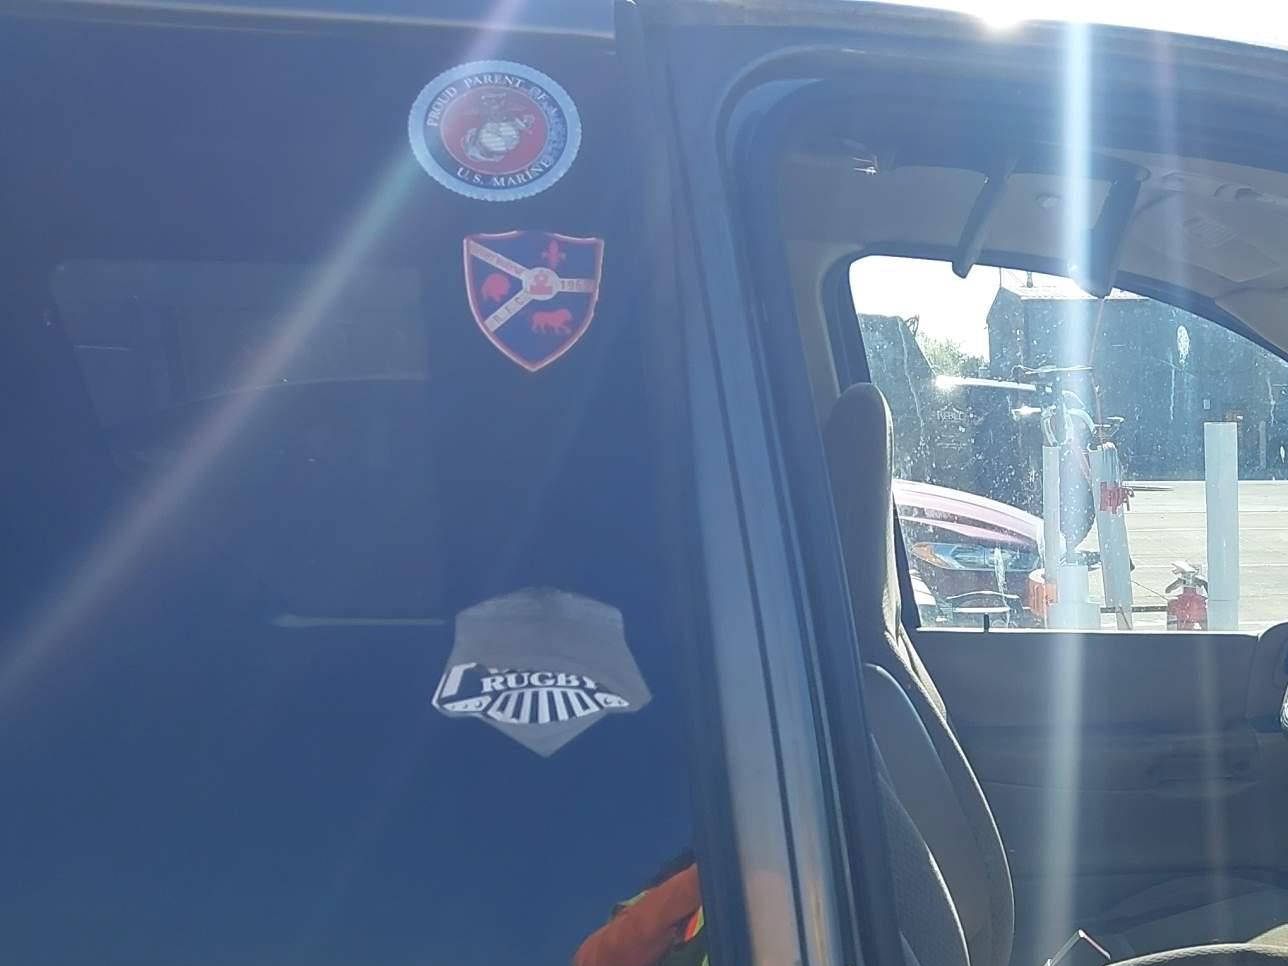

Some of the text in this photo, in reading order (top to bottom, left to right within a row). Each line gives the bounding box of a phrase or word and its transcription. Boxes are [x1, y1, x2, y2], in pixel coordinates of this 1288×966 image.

[427, 87, 458, 127] PROUD
[463, 74, 525, 89] PARENT
[528, 86, 549, 101] OF
[492, 157, 554, 187] MARINE
[481, 672, 599, 693] RUGBY
